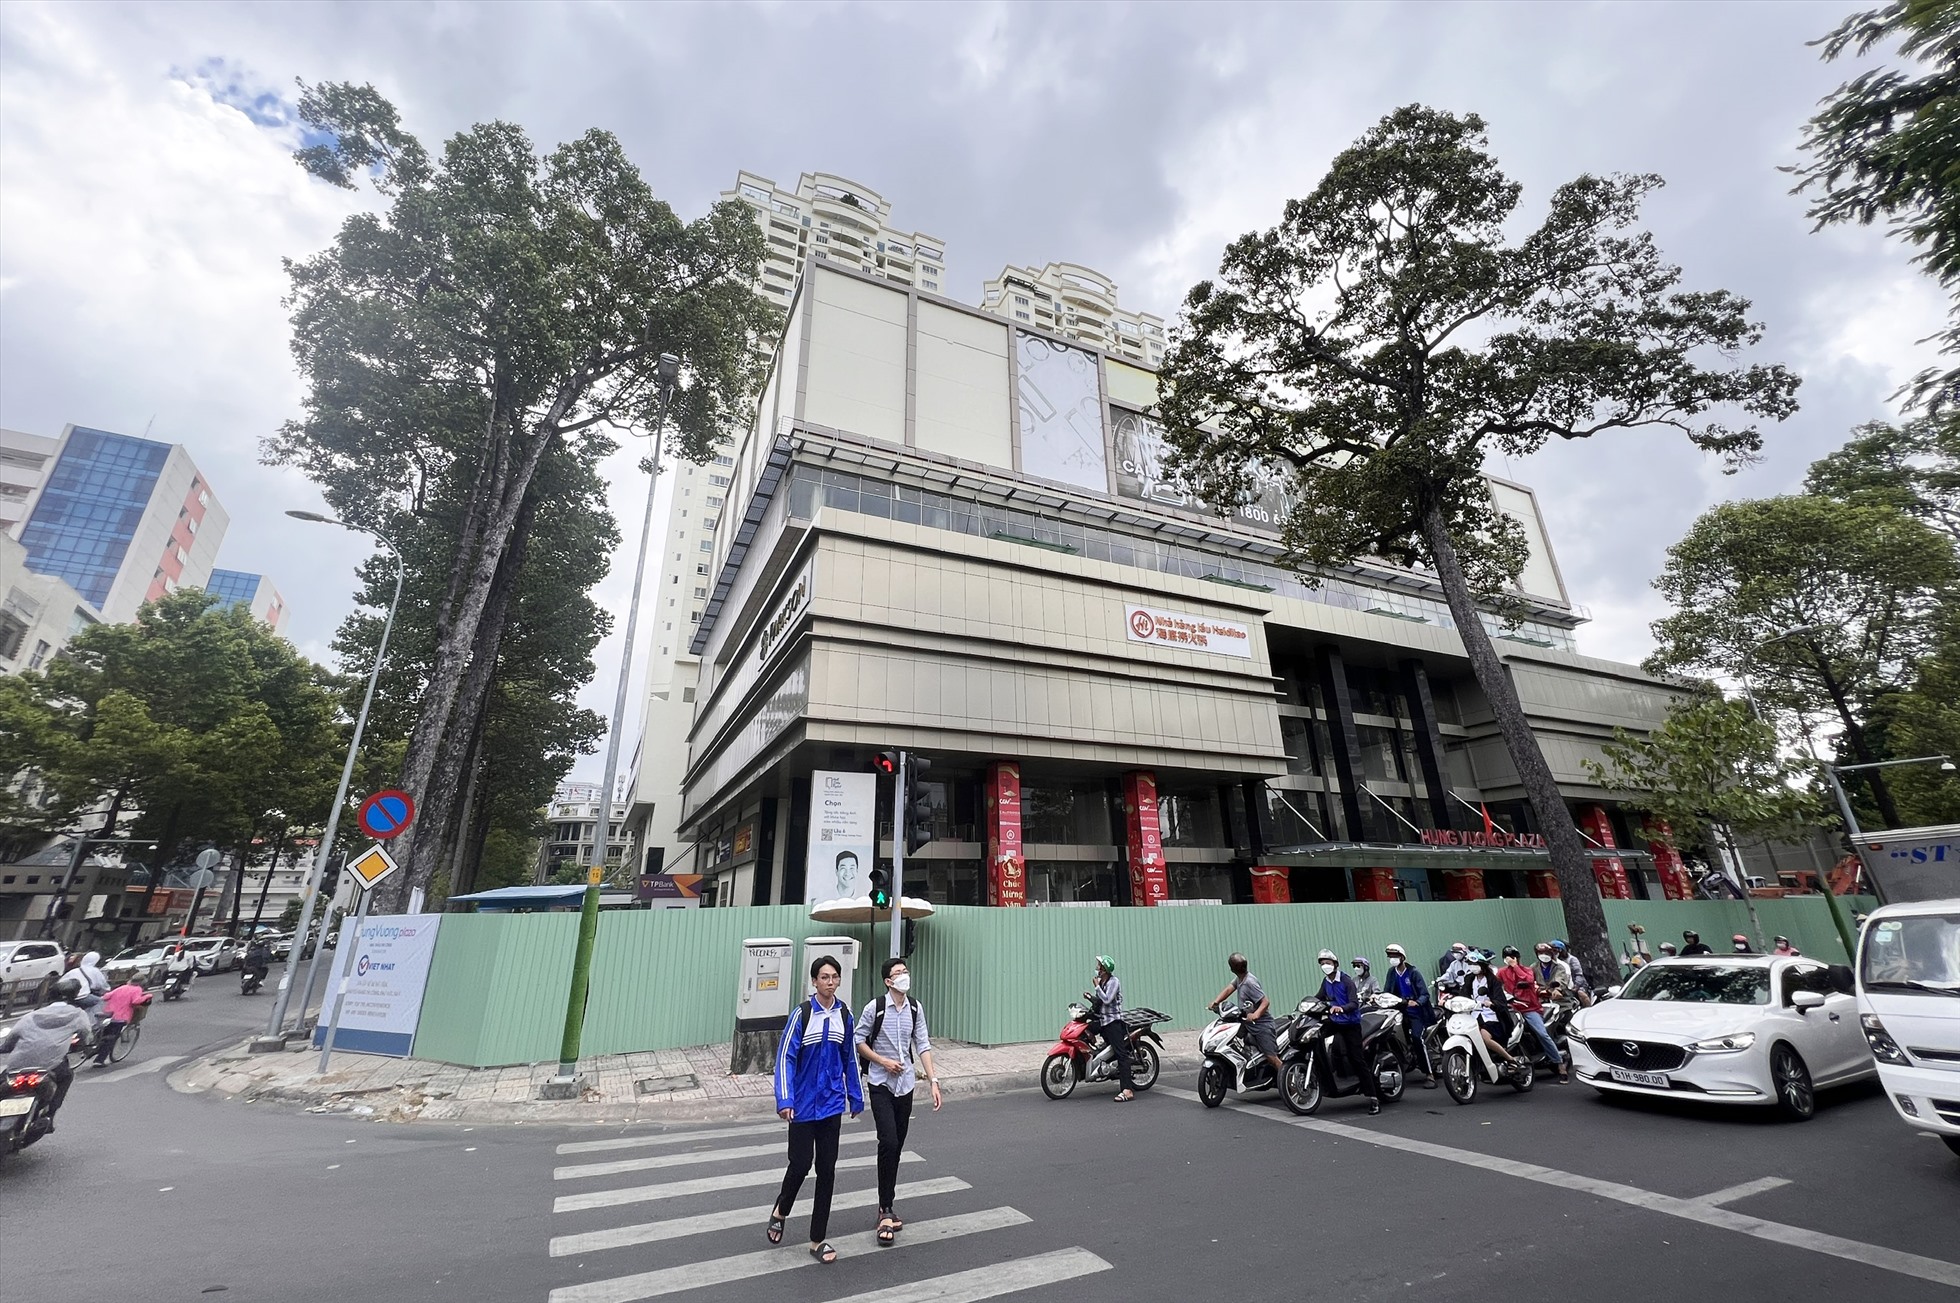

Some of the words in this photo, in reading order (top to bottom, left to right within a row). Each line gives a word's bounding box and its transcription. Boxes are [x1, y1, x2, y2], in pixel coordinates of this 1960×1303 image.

[1239, 505, 1269, 523] 1800
[824, 799, 842, 807] Chọn
[650, 880, 674, 888] TPBank
[1002, 879, 1022, 888] Chúc
[1001, 889, 1023, 900] Mừng
